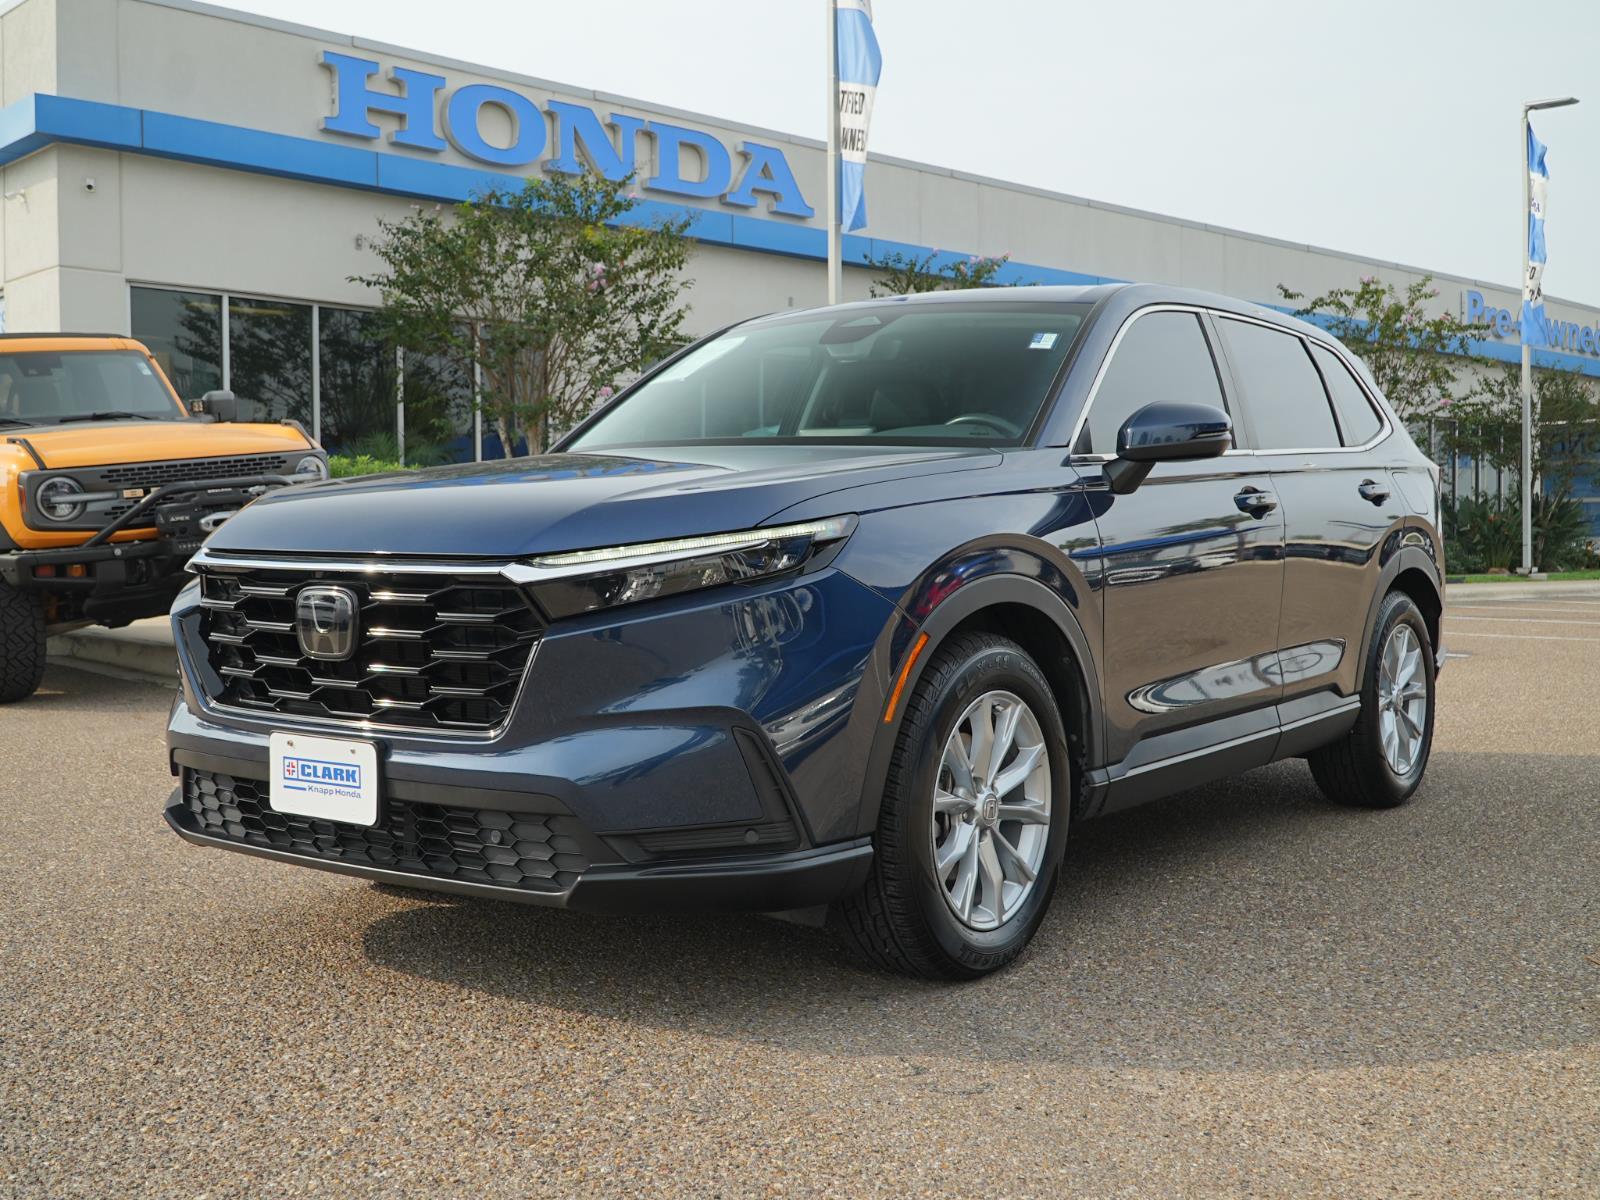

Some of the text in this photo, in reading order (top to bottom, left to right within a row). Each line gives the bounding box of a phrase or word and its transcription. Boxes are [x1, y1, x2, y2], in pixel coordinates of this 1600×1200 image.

[317, 50, 815, 218] HONDA
[1467, 290, 1600, 354] Pre-wne
[301, 764, 357, 783] CLARK
[308, 785, 361, 799] Knapp Honda
